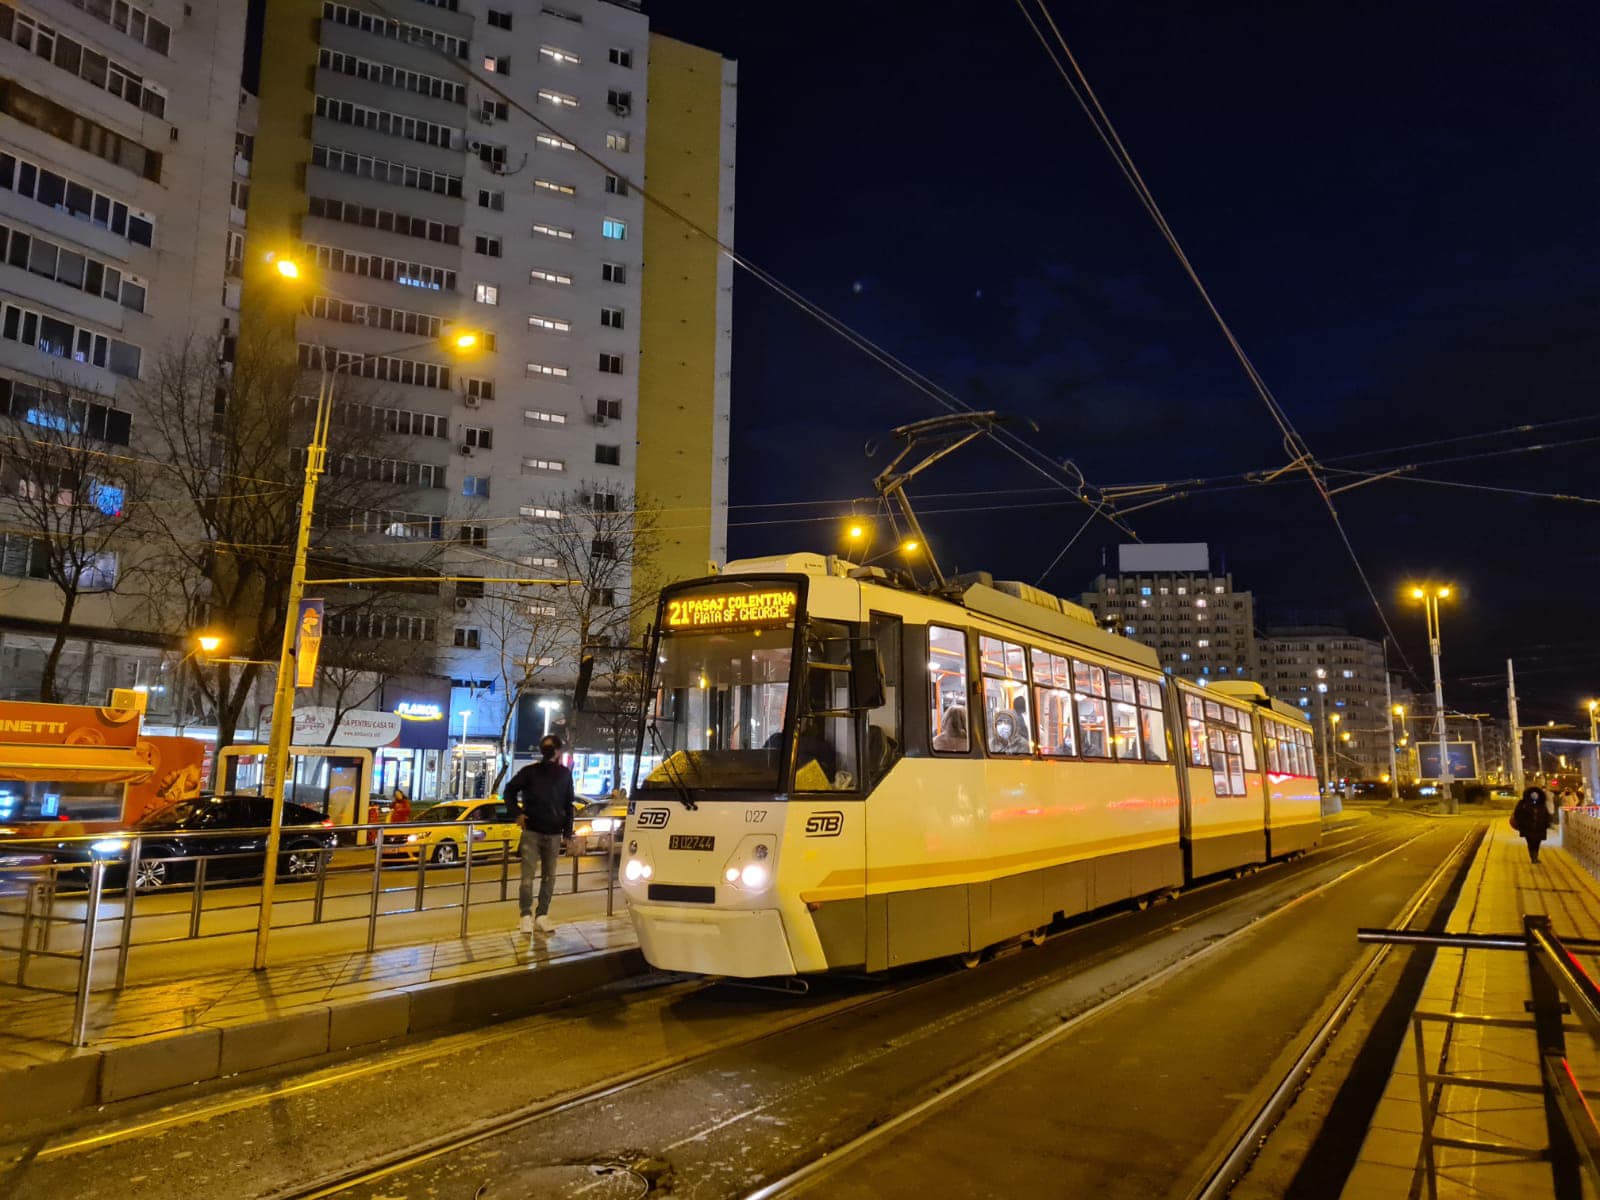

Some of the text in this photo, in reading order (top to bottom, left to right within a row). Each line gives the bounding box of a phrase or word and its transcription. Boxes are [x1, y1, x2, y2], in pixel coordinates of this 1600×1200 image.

[688, 592, 796, 613] PASAJ COLENTINA
[669, 601, 689, 625] 21
[694, 610, 722, 625] PIATA
[740, 604, 790, 620] GHEORGHE
[637, 812, 667, 825] STB
[745, 810, 768, 823] 027
[805, 816, 840, 832] STB
